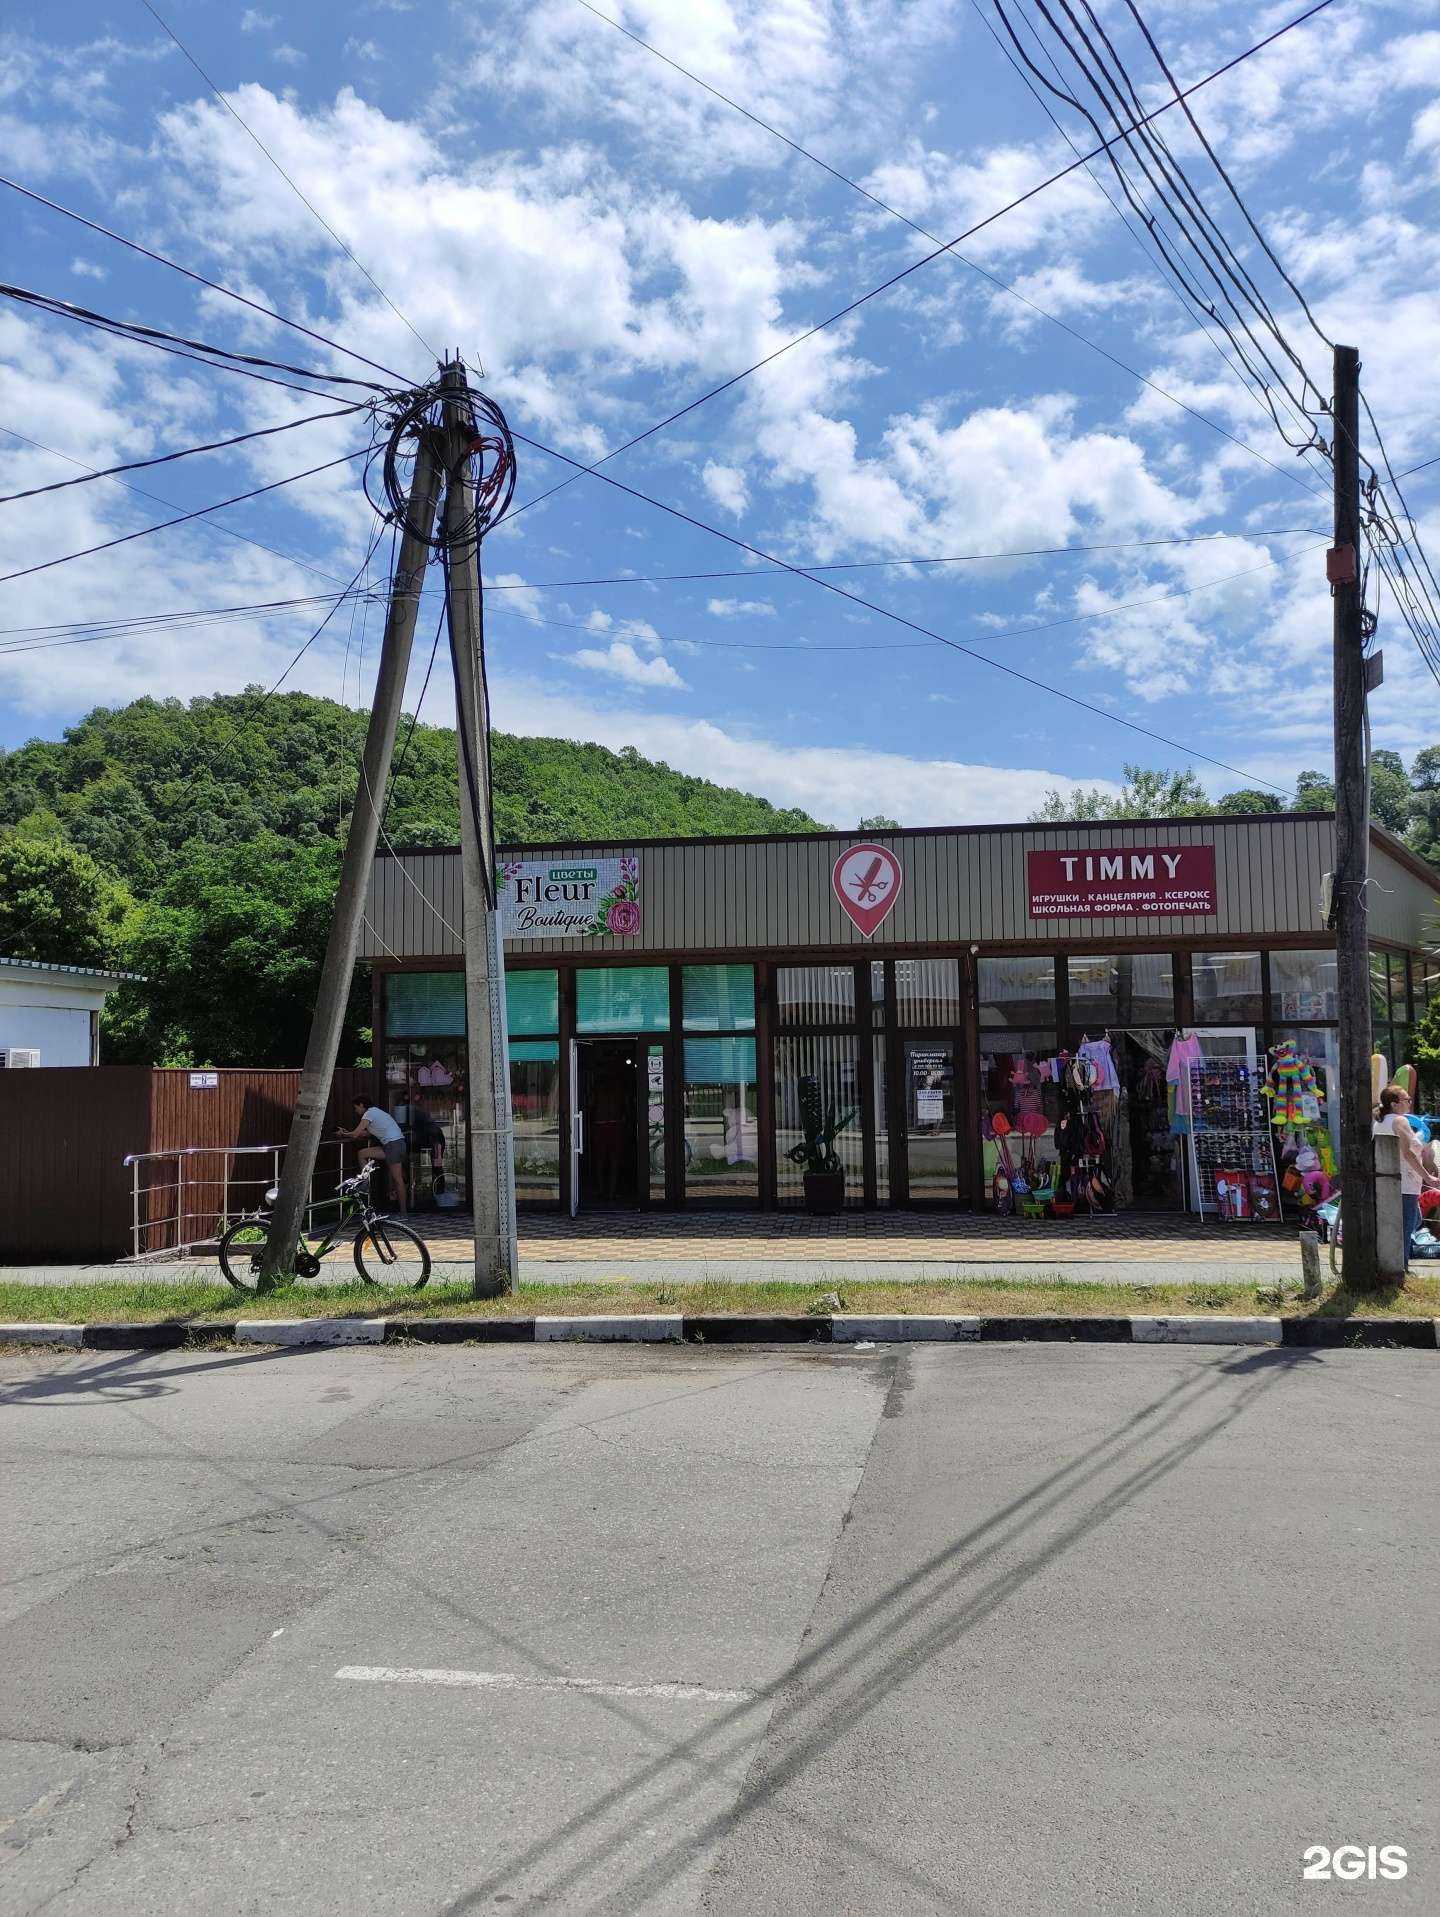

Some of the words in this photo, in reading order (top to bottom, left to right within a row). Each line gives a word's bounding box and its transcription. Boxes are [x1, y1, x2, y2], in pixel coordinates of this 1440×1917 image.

[552, 870, 593, 880] цветы
[1060, 854, 1183, 881] TIMMY
[515, 877, 596, 903] Fleur
[1032, 894, 1080, 903] ИГРУШКИ
[1088, 892, 1156, 902] КАНЦЕЛЯРИЯ
[1165, 890, 1211, 900] КСЕРОКС
[1032, 904, 1091, 914] ШКОЛЬНАЯ
[1094, 903, 1133, 912] ФОРМА
[1142, 902, 1211, 911] ФОТОПЕЧАТЬ
[517, 906, 594, 933] Boutique
